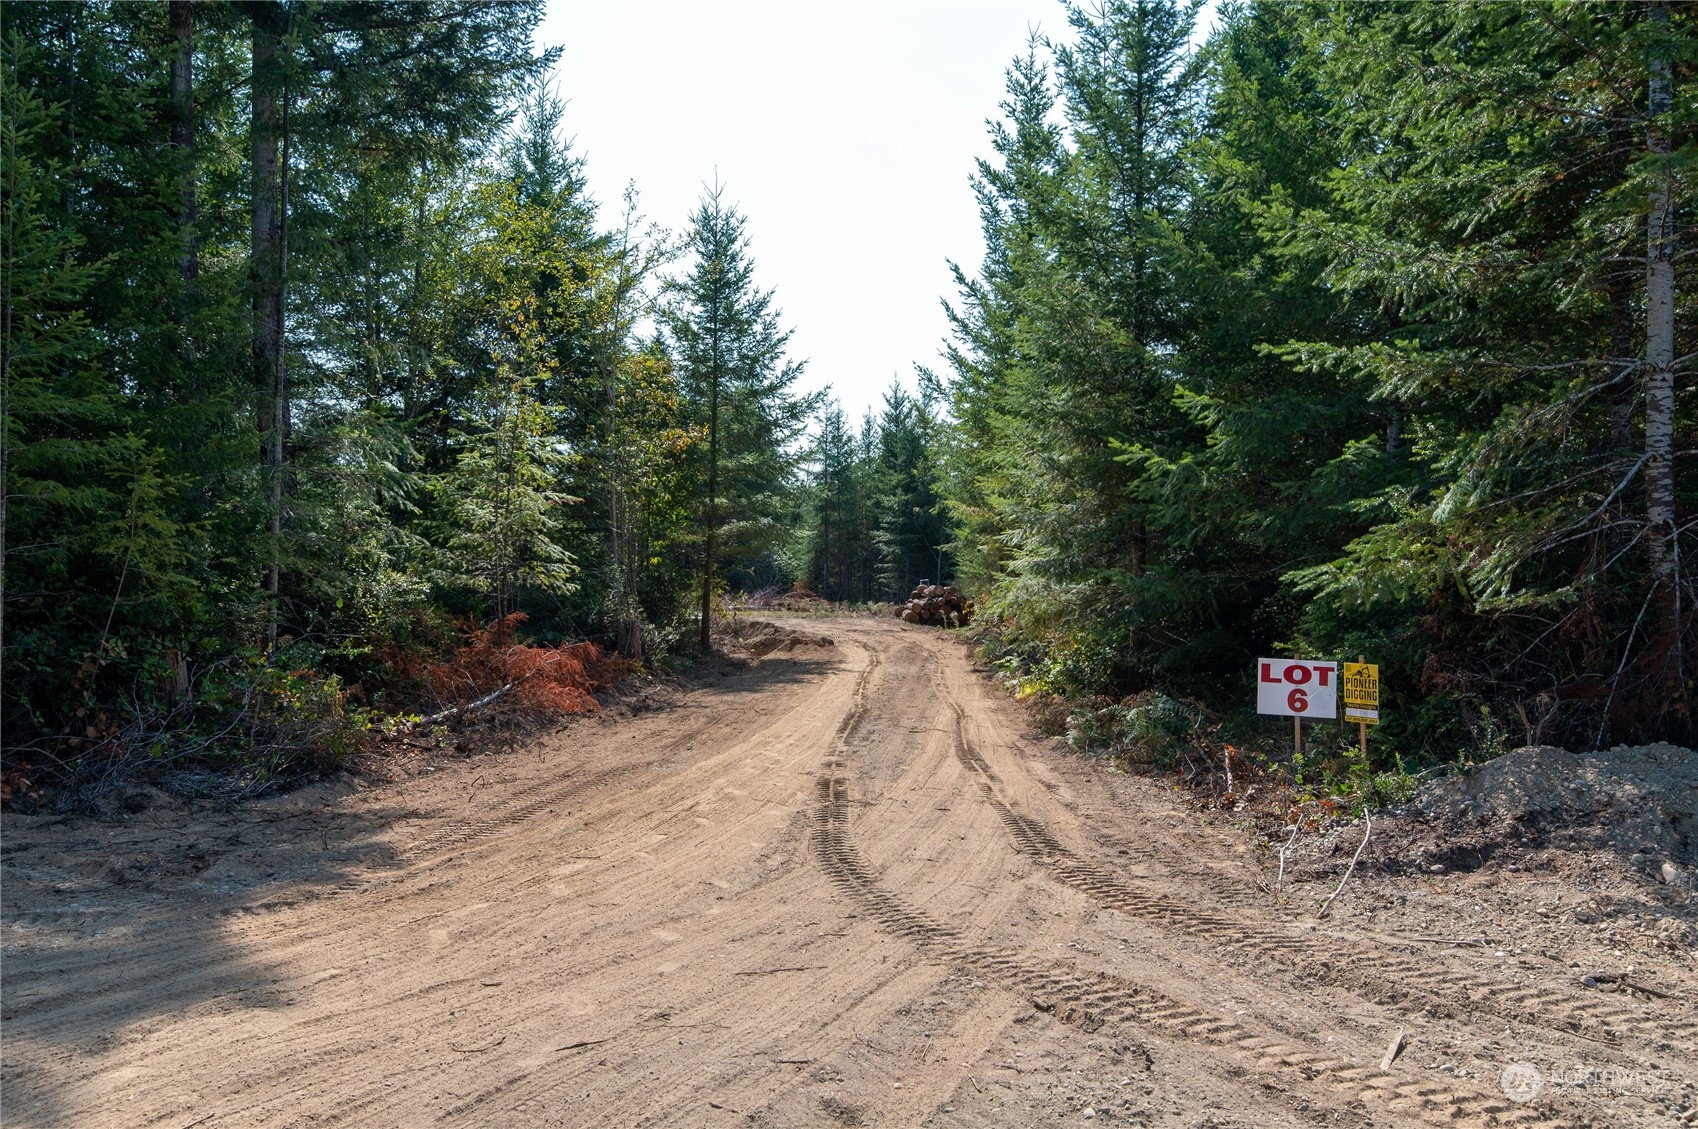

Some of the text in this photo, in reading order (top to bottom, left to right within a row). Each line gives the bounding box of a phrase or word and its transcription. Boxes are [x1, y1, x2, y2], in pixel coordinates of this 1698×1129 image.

[1260, 663, 1335, 686] LOT
[1345, 678, 1377, 689] PIONEER
[1287, 688, 1309, 712] 6
[1345, 689, 1378, 701] DIGGING
